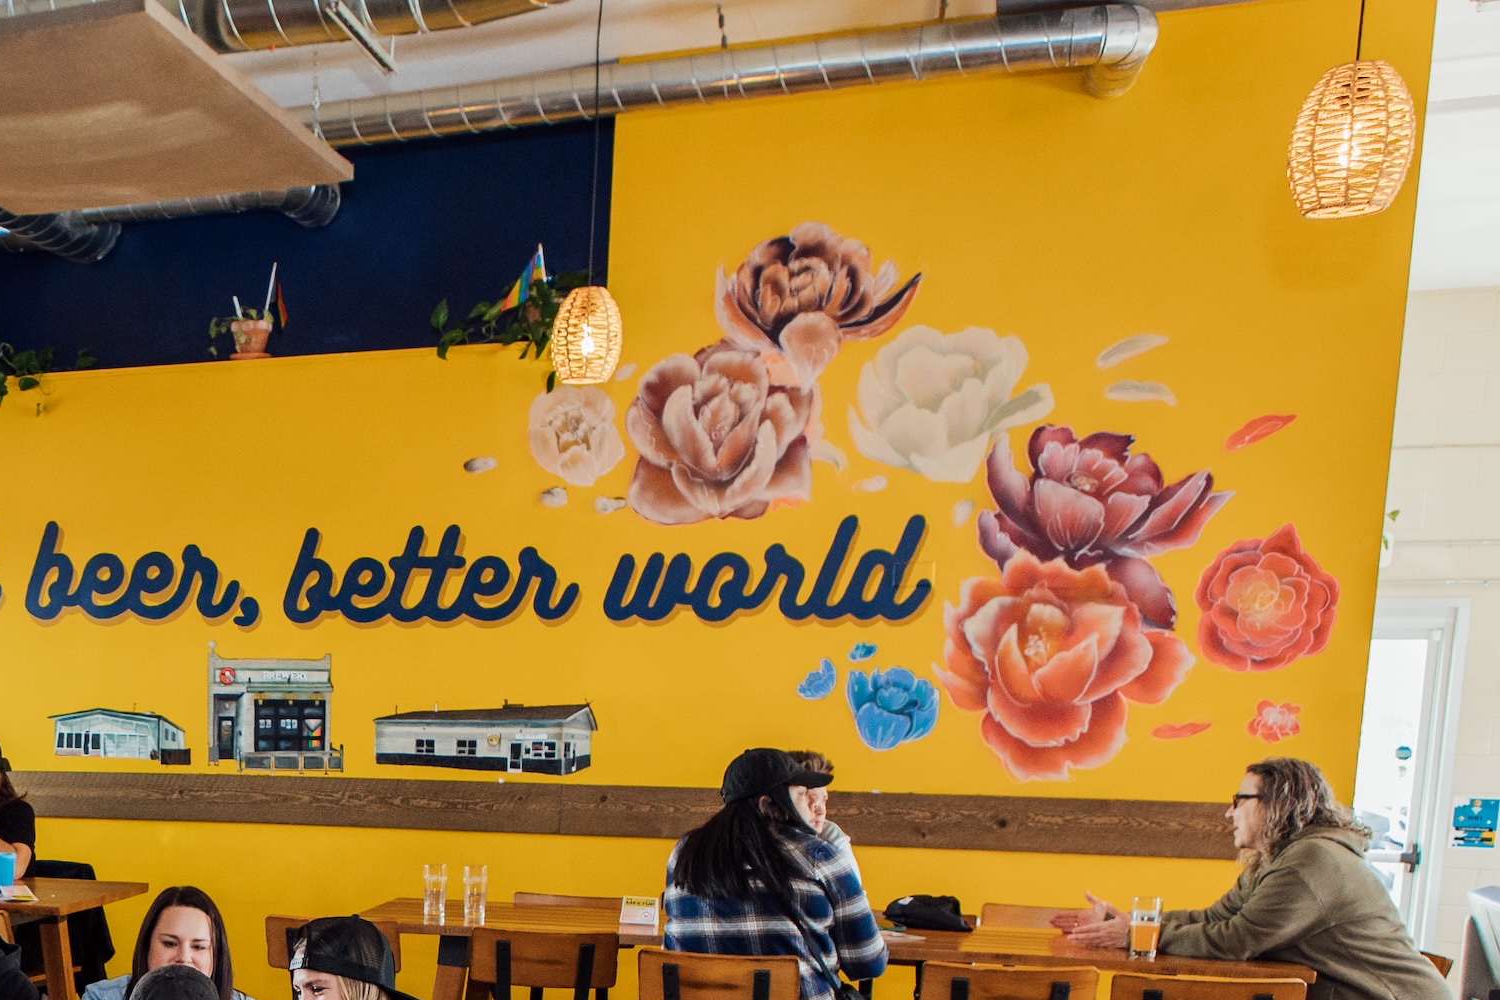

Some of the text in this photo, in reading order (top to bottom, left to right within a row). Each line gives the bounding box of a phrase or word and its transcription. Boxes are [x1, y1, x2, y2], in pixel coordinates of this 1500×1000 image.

[25, 520, 261, 628] beer,
[283, 524, 581, 624] better
[603, 514, 933, 623] world
[263, 671, 307, 680] BREWERY
